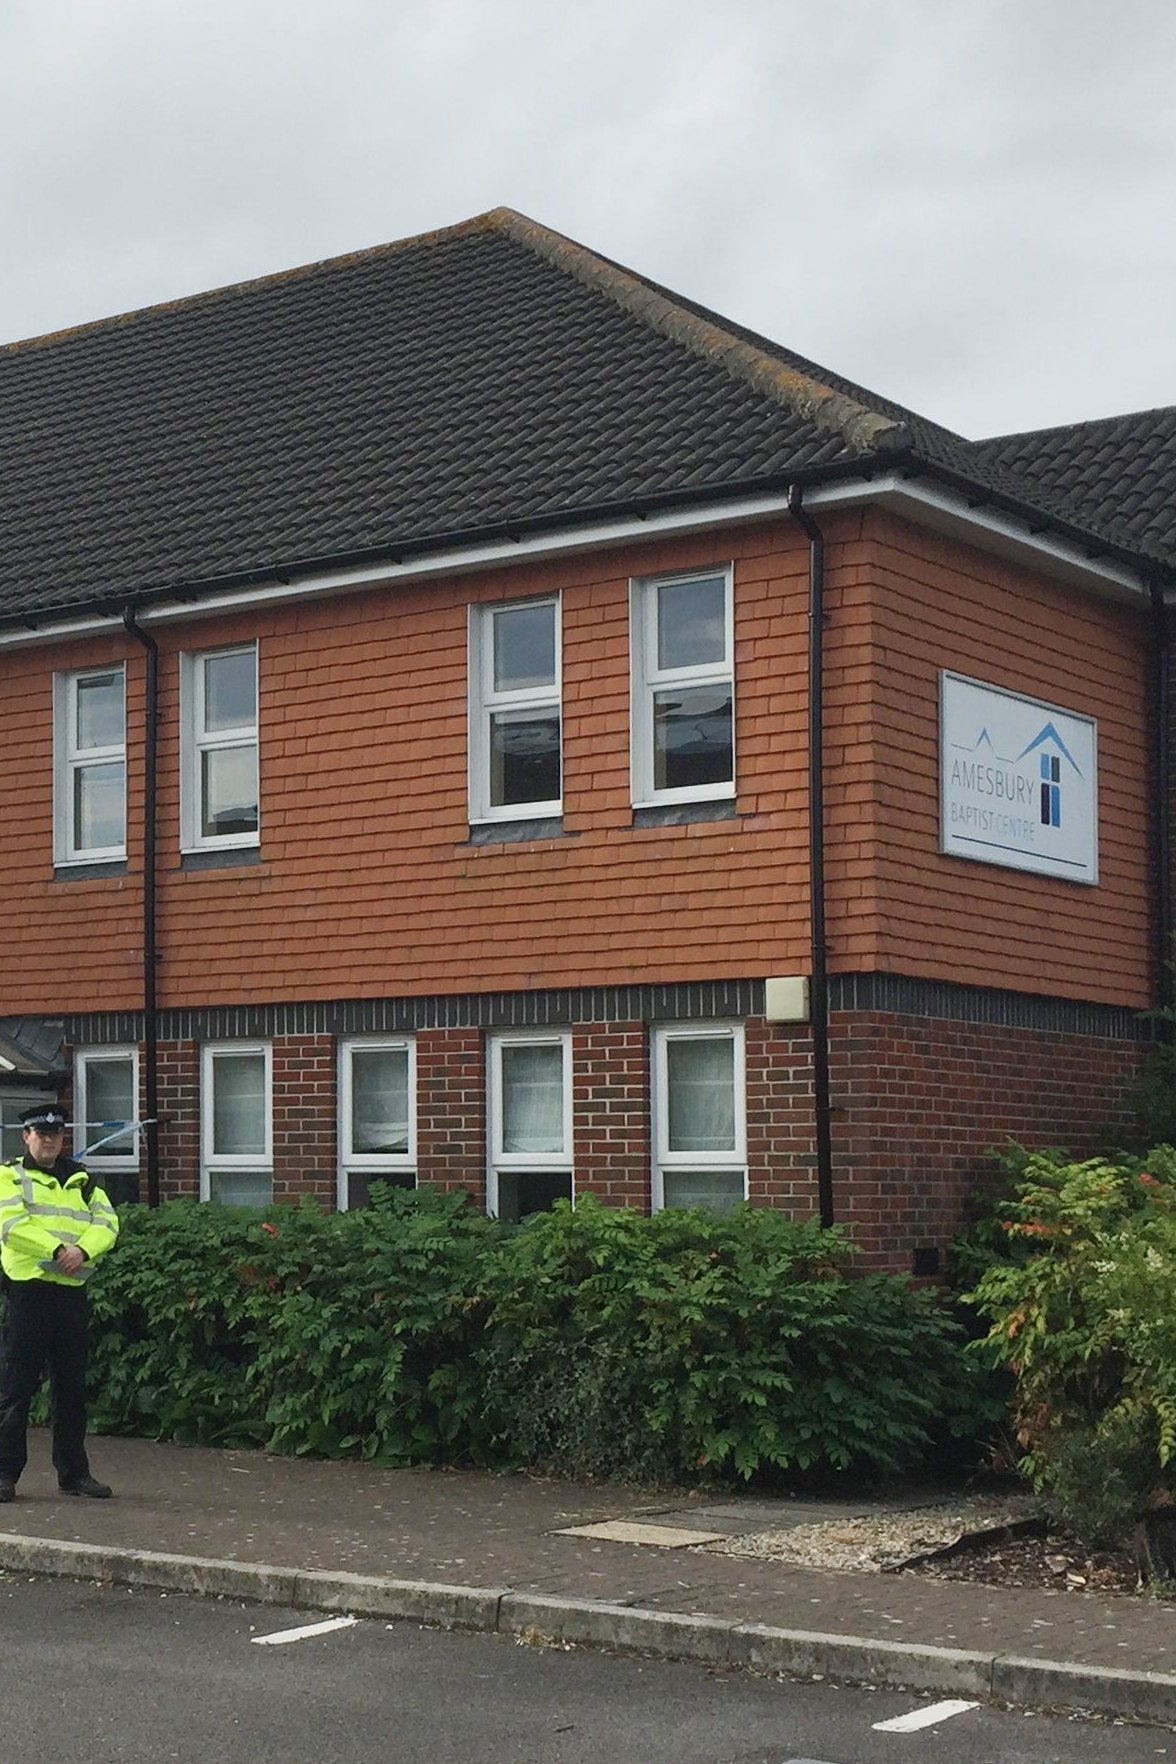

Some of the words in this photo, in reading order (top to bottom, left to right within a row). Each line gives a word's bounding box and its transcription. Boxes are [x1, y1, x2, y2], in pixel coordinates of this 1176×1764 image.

[951, 758, 1034, 805] AMESBURY
[951, 801, 994, 830] BAPTIST
[995, 813, 1035, 841] CENTRE
